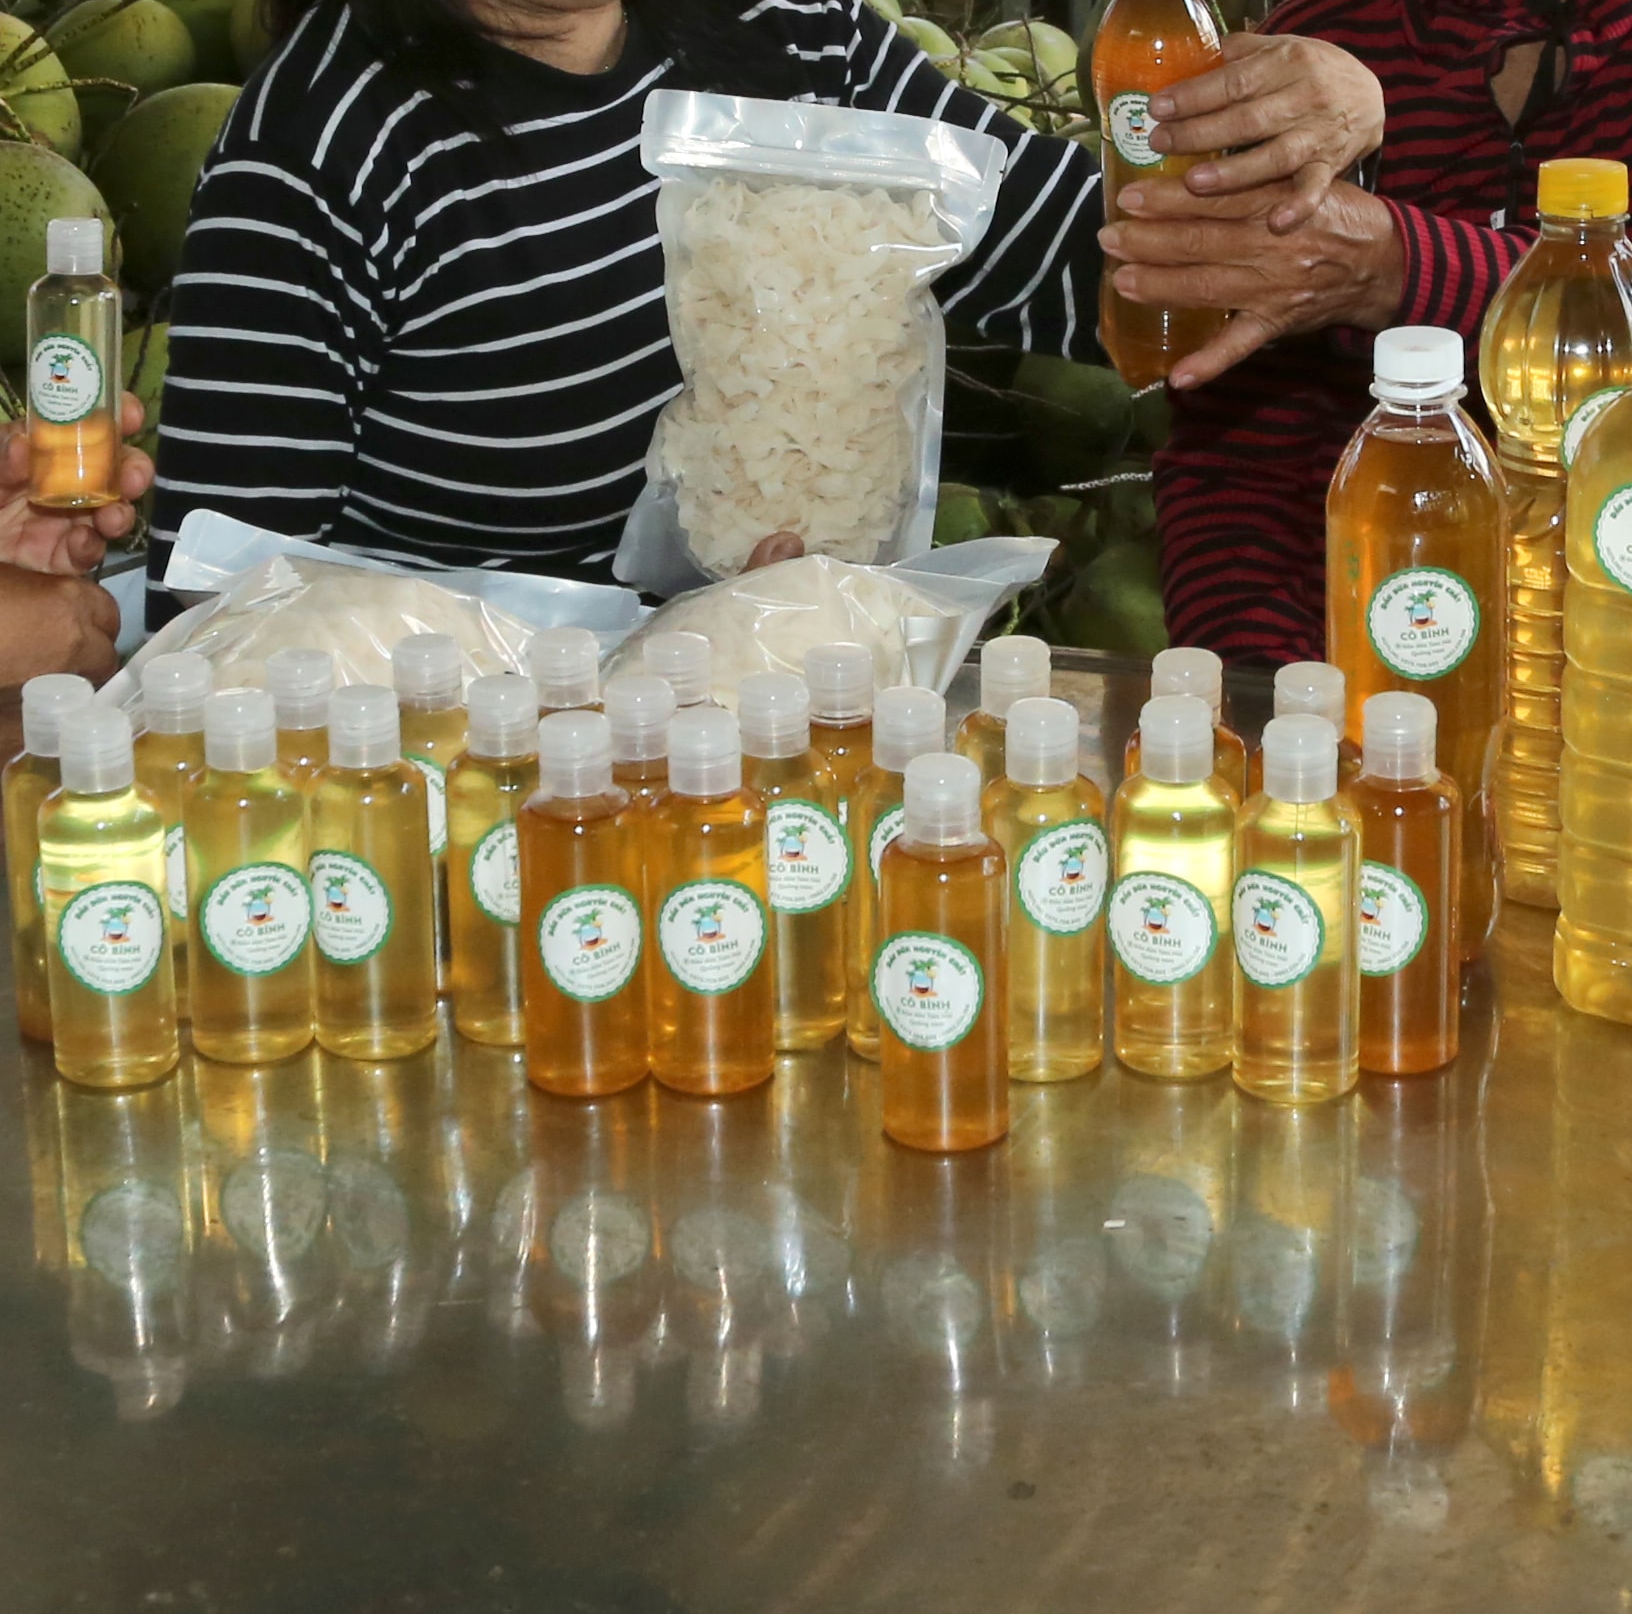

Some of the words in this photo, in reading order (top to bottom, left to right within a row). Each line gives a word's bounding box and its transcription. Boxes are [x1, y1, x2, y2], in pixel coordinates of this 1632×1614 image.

[1400, 631, 1417, 641] CÔ
[1421, 628, 1449, 639] BÌNH
[790, 863, 819, 874] BÌNH
[1049, 886, 1065, 896] CÔ
[1070, 883, 1093, 895] BÌNH
[236, 927, 253, 937] CÔ
[257, 923, 285, 936] BÌNH
[1133, 931, 1149, 943] CÔ
[1152, 936, 1181, 948] BÌNH
[90, 945, 107, 954] CÔ
[688, 945, 705, 955] CÔ
[709, 940, 738, 953] BÌNH
[572, 953, 590, 965] CÔ
[901, 997, 916, 1007] CÔ
[920, 1000, 950, 1010] BÌNH
